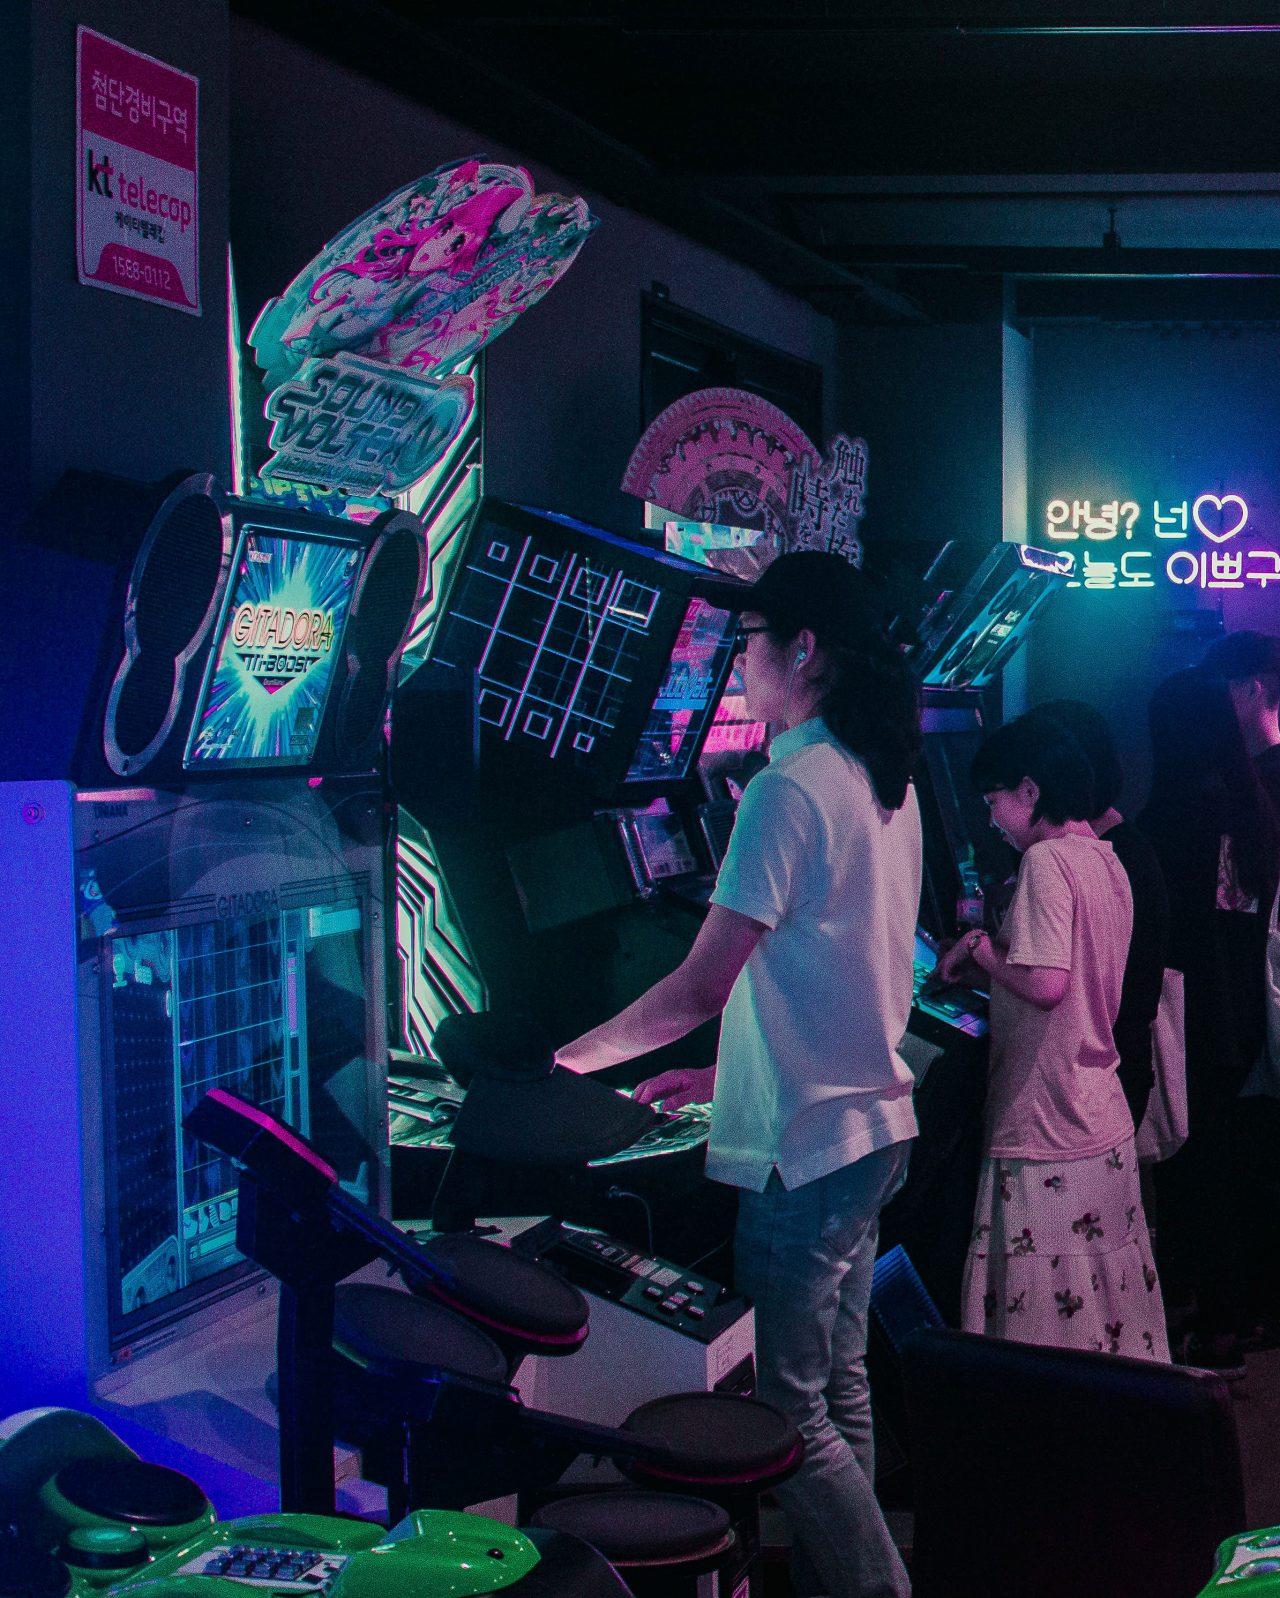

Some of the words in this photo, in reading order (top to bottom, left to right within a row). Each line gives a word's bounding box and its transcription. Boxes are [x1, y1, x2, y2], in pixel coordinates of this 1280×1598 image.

[92, 70, 188, 144] 첨단경비구역
[87, 148, 114, 198] kt
[118, 172, 192, 233] telecop
[1046, 500, 1140, 540] 안녕?
[1153, 500, 1188, 539] 넌
[232, 603, 334, 651] GITADORA
